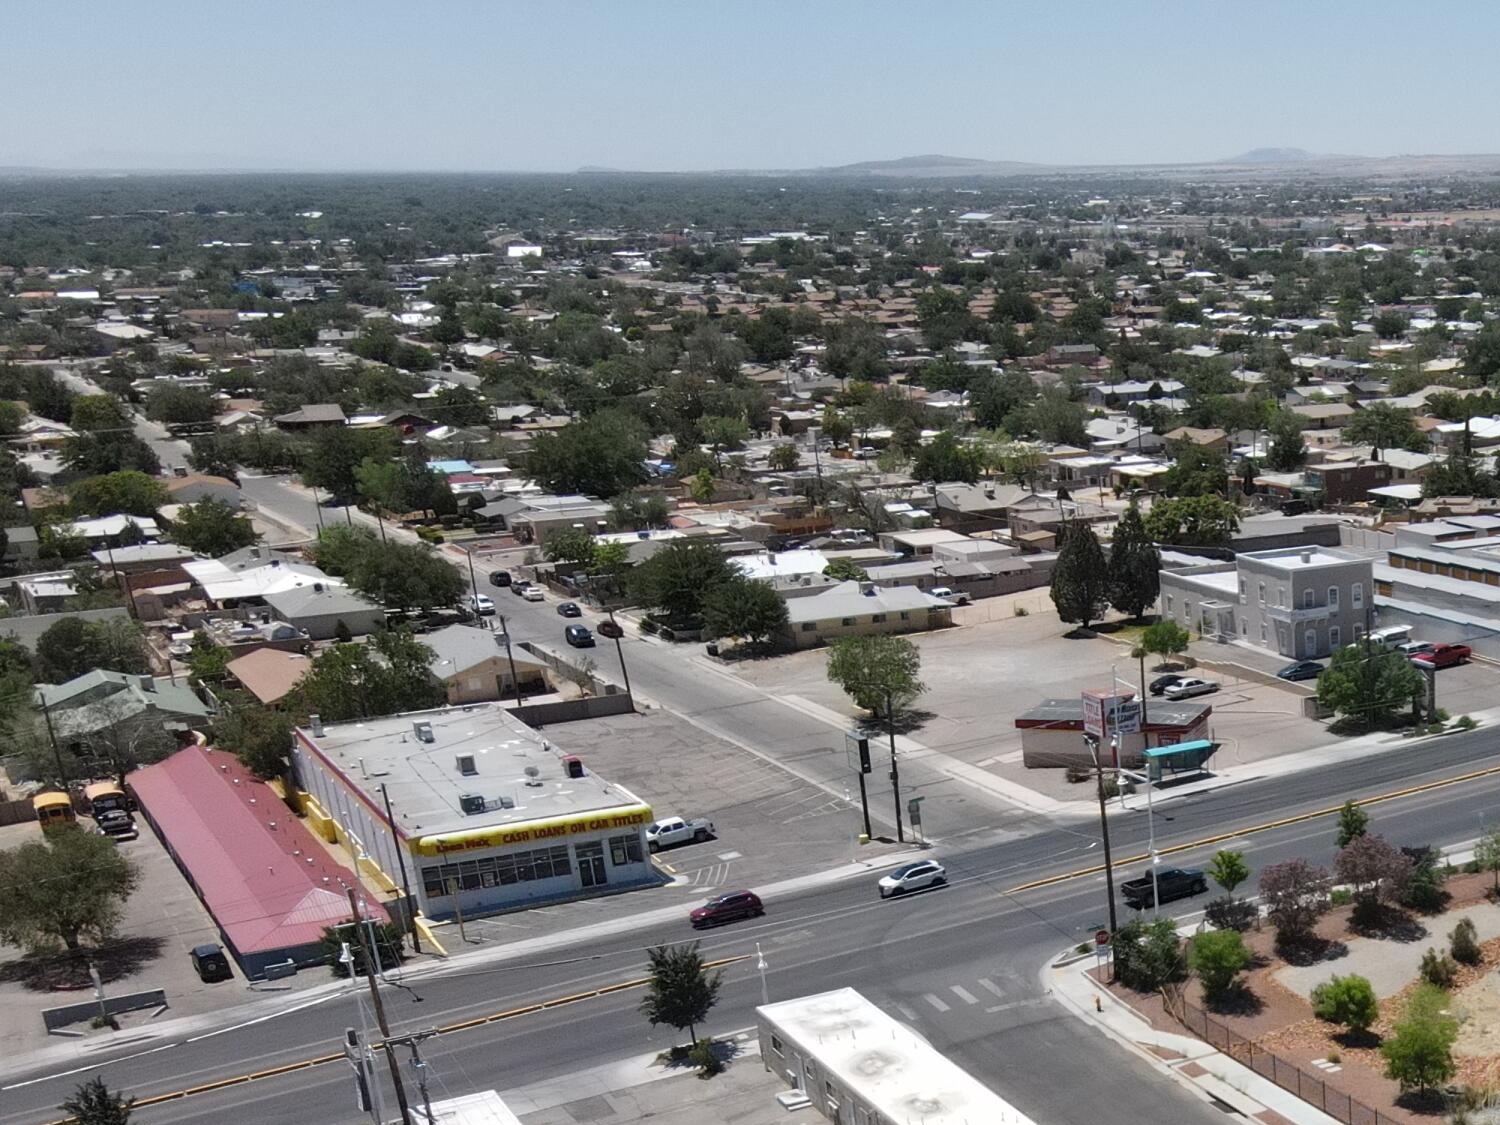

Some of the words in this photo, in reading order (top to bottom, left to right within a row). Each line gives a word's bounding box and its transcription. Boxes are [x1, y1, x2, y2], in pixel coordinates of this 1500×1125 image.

[503, 831, 529, 843] CASH
[534, 826, 566, 839] LOANS
[571, 823, 585, 833] ON
[590, 819, 609, 830] CAR
[614, 814, 643, 827] TITLES
